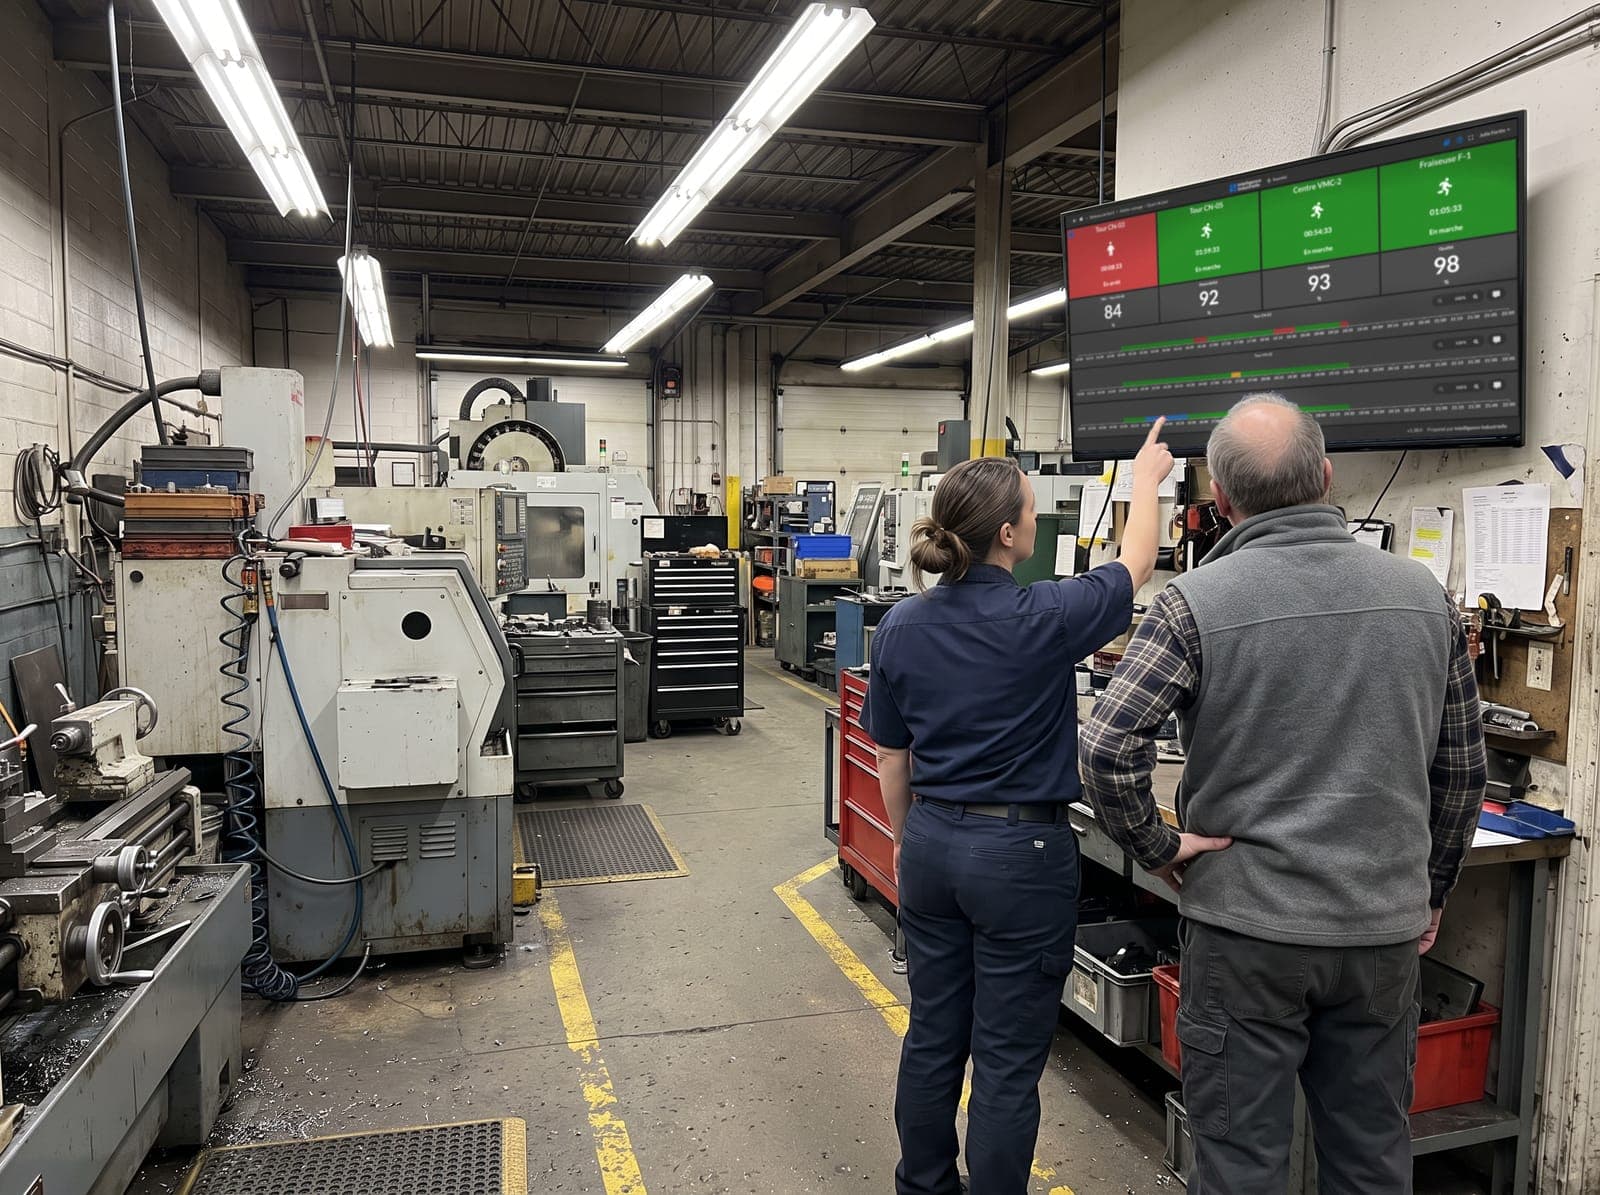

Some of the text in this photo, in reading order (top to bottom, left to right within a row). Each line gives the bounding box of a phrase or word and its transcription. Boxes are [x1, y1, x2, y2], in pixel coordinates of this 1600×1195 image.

[1419, 151, 1471, 169] Fraiseuse F-1
[1293, 178, 1342, 194] Centre VMC-2
[1190, 206, 1203, 215] Tour
[1429, 204, 1463, 216] 01:05:33
[1095, 224, 1107, 233] Tour
[1429, 225, 1464, 236] En marche
[1304, 246, 1333, 256] En marche
[1434, 254, 1460, 275] 98
[1308, 274, 1330, 291] 93
[1199, 289, 1219, 306] 92
[1104, 303, 1122, 319] 84
